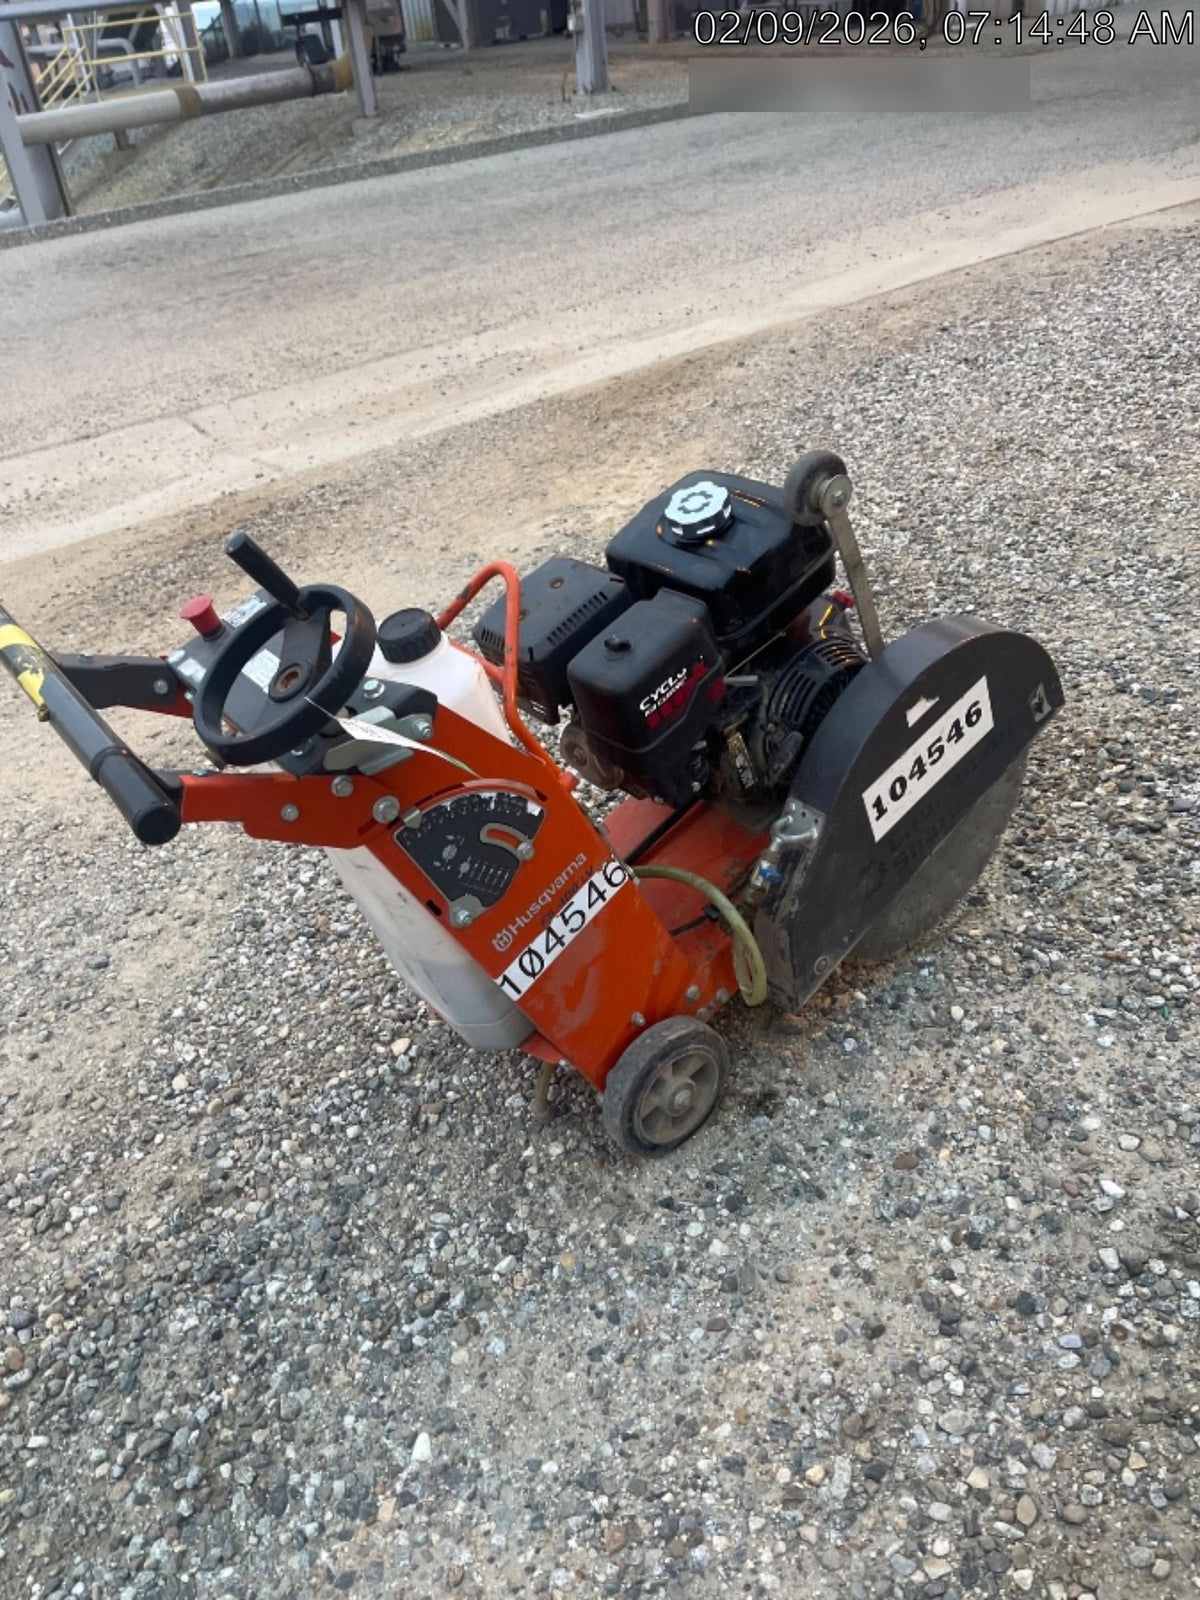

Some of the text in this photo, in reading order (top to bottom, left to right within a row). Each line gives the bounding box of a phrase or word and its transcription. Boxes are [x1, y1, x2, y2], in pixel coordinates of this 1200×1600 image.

[872, 700, 982, 821] 104546
[499, 861, 628, 995] 104546
[509, 853, 587, 935] Husqvarna
